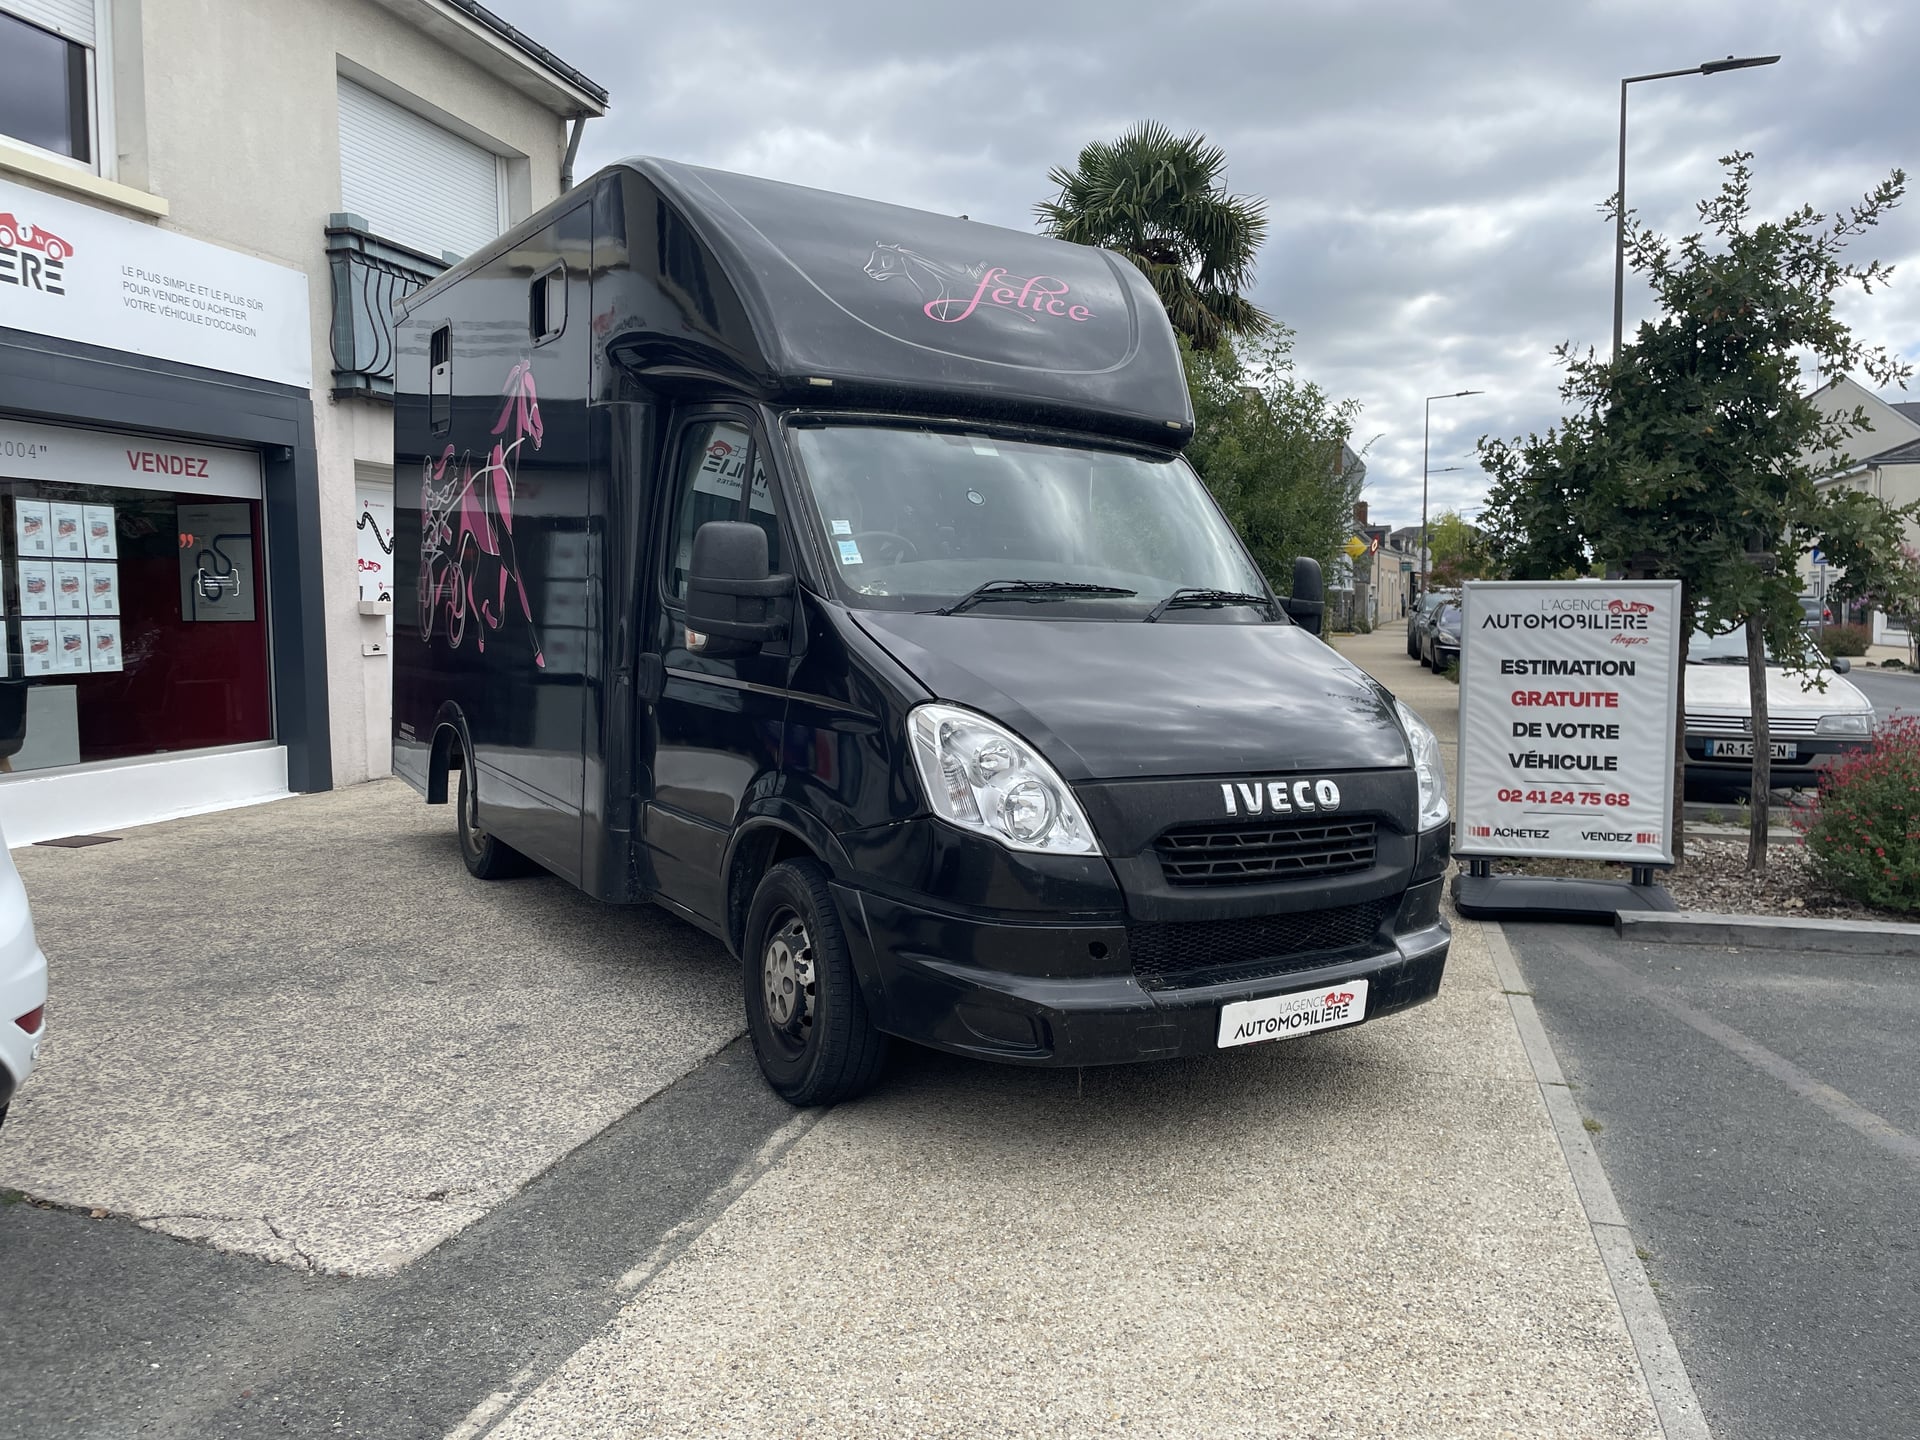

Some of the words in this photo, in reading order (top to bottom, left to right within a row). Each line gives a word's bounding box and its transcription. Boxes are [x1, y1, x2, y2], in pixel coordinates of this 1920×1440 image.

[122, 265, 134, 278] LE
[136, 268, 161, 285] PLUS
[163, 276, 196, 294] SIMPLE
[198, 285, 209, 297] ET
[211, 288, 222, 301] LE
[224, 292, 246, 308] PLUS
[247, 298, 264, 311] SÛR
[122, 280, 150, 297] POUR
[152, 288, 191, 307] VENDRE
[192, 299, 206, 311] OU
[207, 303, 248, 321] ACHETER
[123, 296, 157, 314] VOTRE
[158, 304, 204, 325] VÉHICULE
[205, 316, 257, 338] D'OCCASION
[0, 440, 48, 459] 004"
[126, 450, 209, 478] VENDEZ
[1541, 599, 1609, 611] L'AGENCE
[1610, 633, 1649, 648] Angers
[1500, 659, 1636, 676] ESTIMATION
[1511, 690, 1619, 708] GRATUITE
[1512, 722, 1542, 738] DE
[1545, 723, 1620, 740] VOTRE
[1508, 750, 1618, 771] VÉHICULE
[1221, 779, 1341, 816] IVECO
[1497, 789, 1523, 803] 02
[1525, 790, 1547, 804] 41
[1550, 791, 1576, 805] 24
[1578, 792, 1601, 806] 75
[1604, 793, 1630, 807] 68
[1493, 827, 1550, 839] ACHETEZ
[1581, 831, 1633, 843] VENDEZ
[1279, 995, 1326, 1015] L'AGENCE
